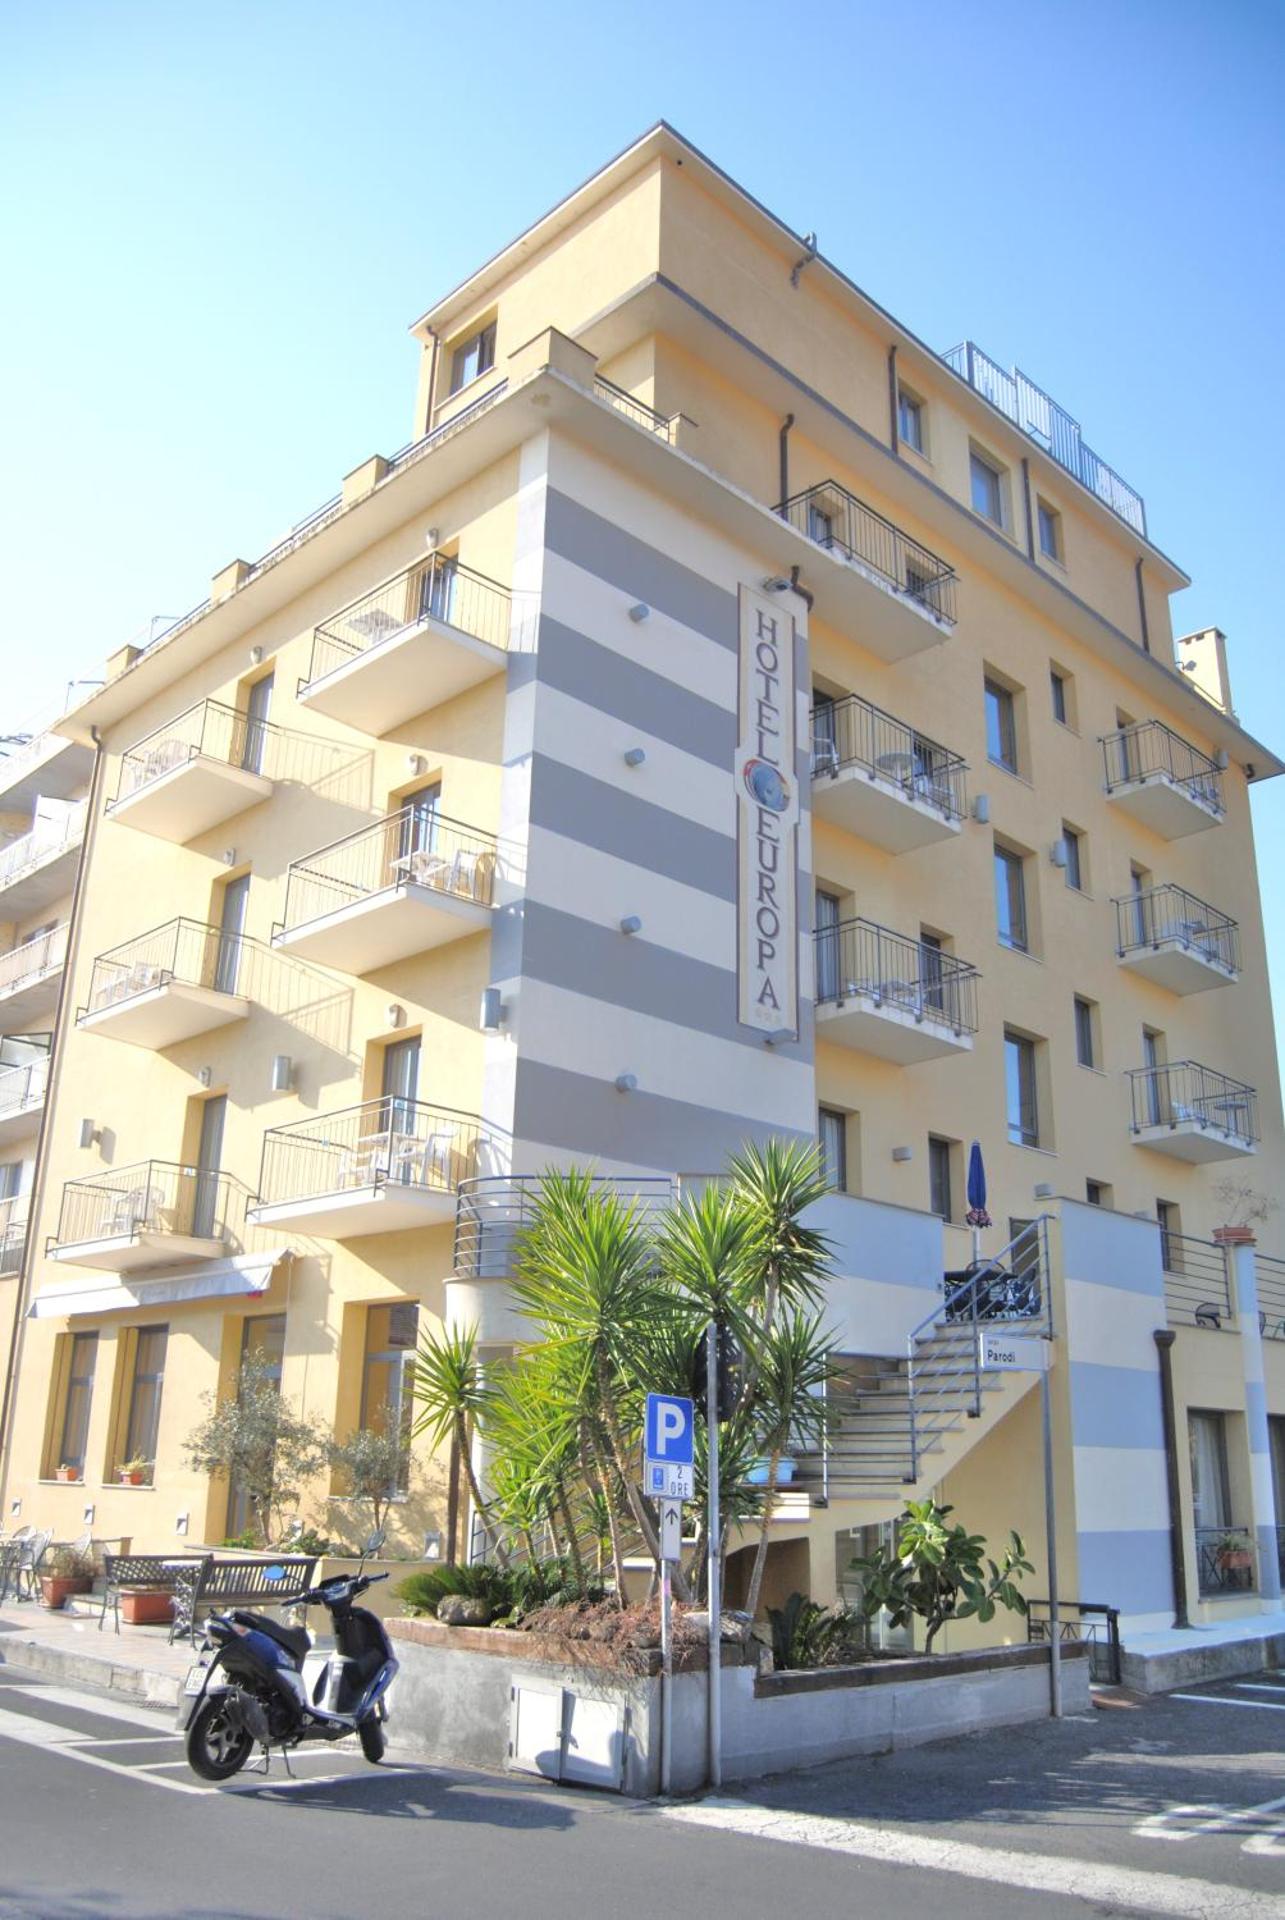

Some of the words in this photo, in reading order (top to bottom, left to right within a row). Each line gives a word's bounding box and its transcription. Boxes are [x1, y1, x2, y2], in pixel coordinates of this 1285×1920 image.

[755, 608, 780, 766] HOTEL
[756, 805, 781, 1011] EUROPA
[987, 1349, 1015, 1363] Parodi
[656, 1402, 686, 1455] P
[670, 1481, 689, 1496] ORE
[677, 1464, 684, 1480] 2
